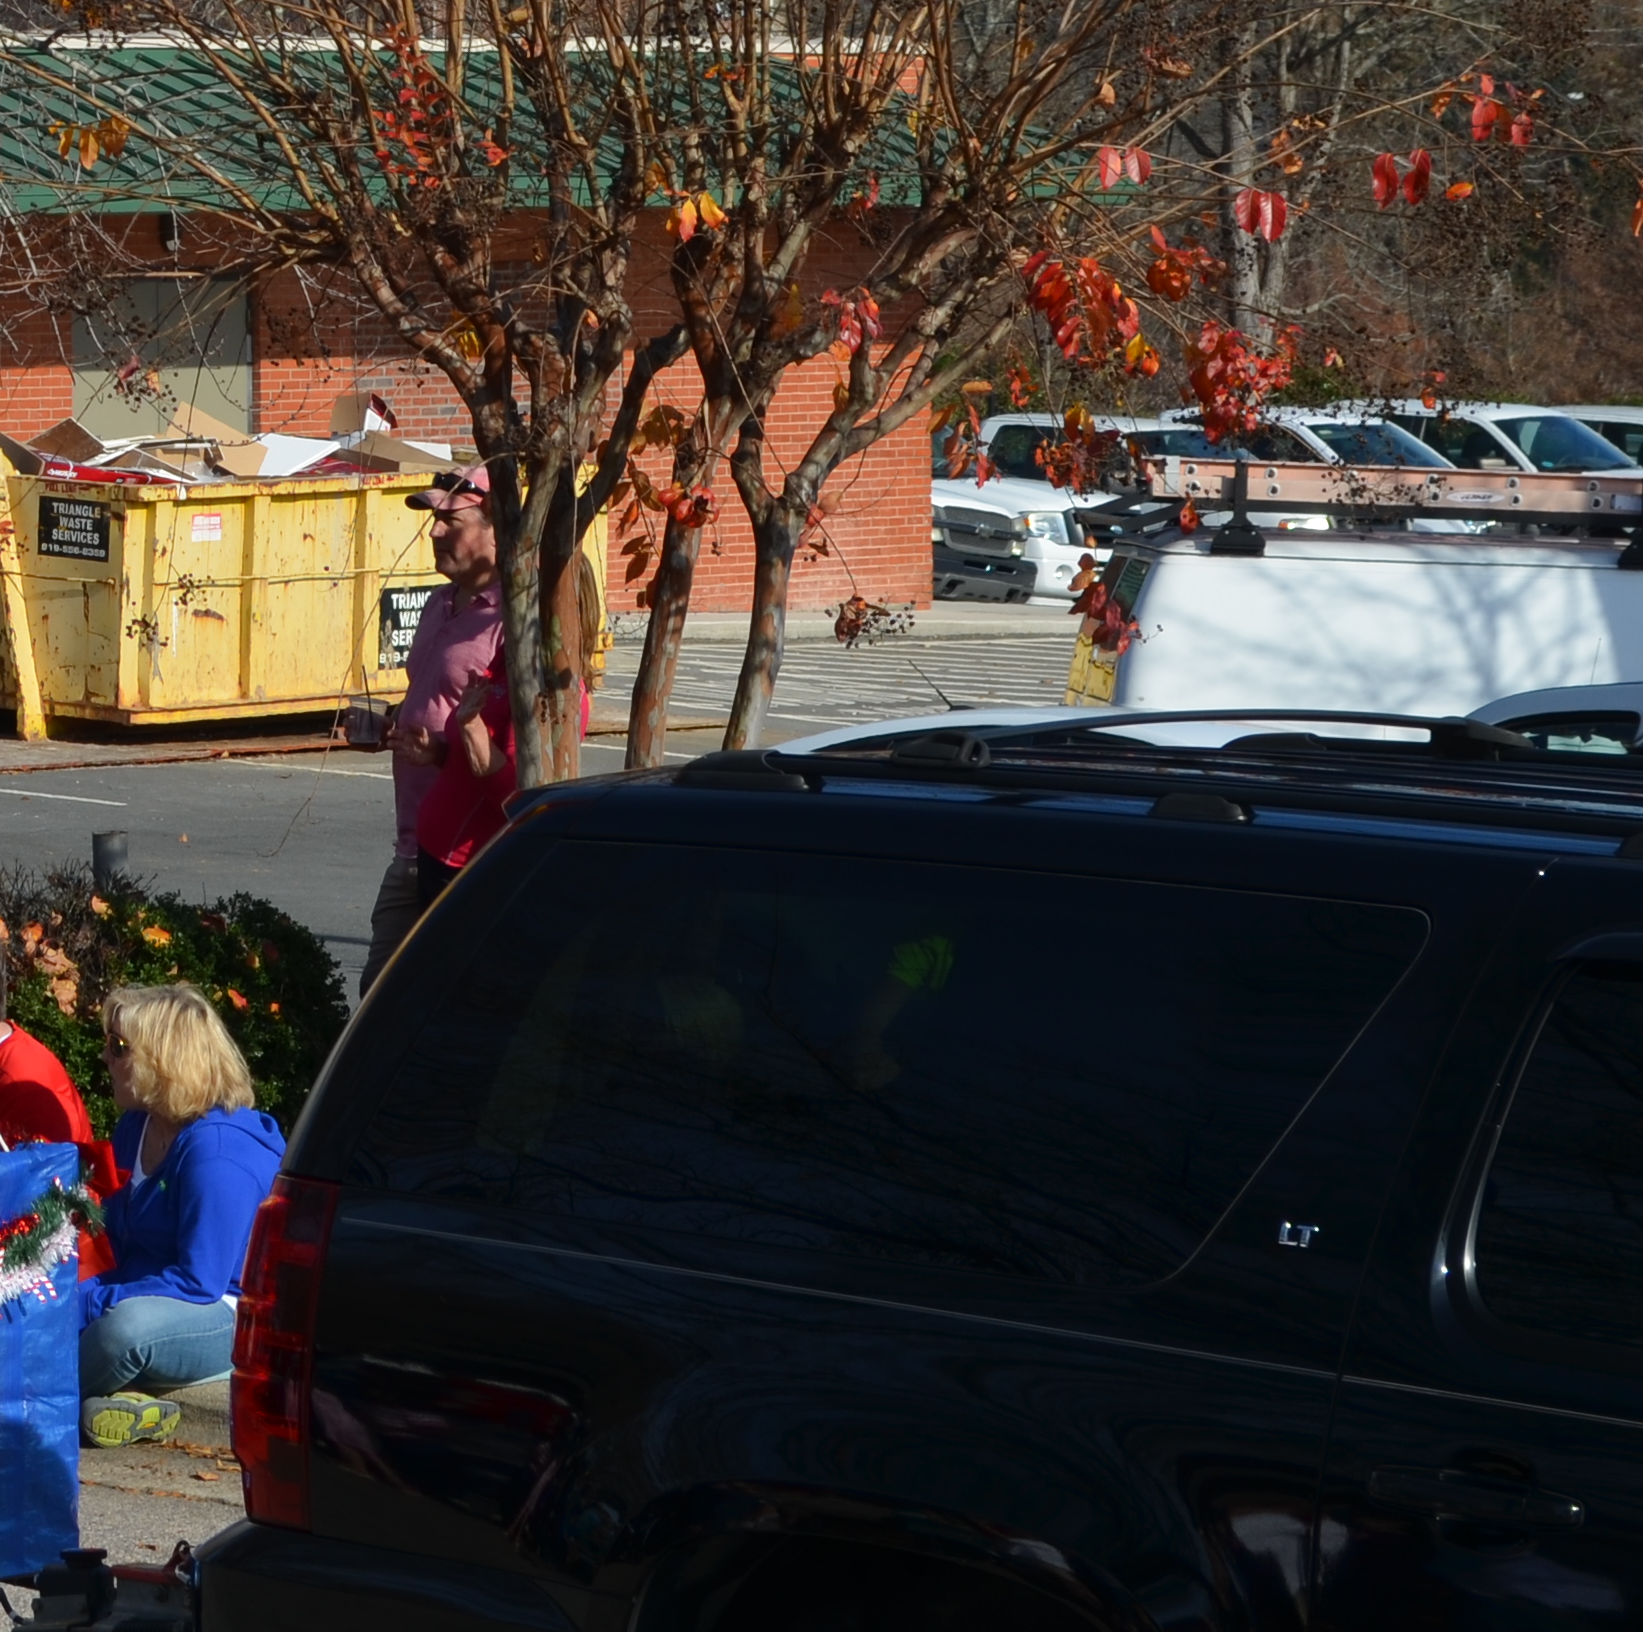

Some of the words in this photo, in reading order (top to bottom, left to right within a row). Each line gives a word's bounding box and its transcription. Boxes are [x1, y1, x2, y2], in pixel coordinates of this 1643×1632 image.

[52, 502, 101, 519] TRIANGLE
[59, 515, 94, 531] WASTE
[51, 529, 100, 546] SERVICES
[1278, 1221, 1320, 1248] LT
